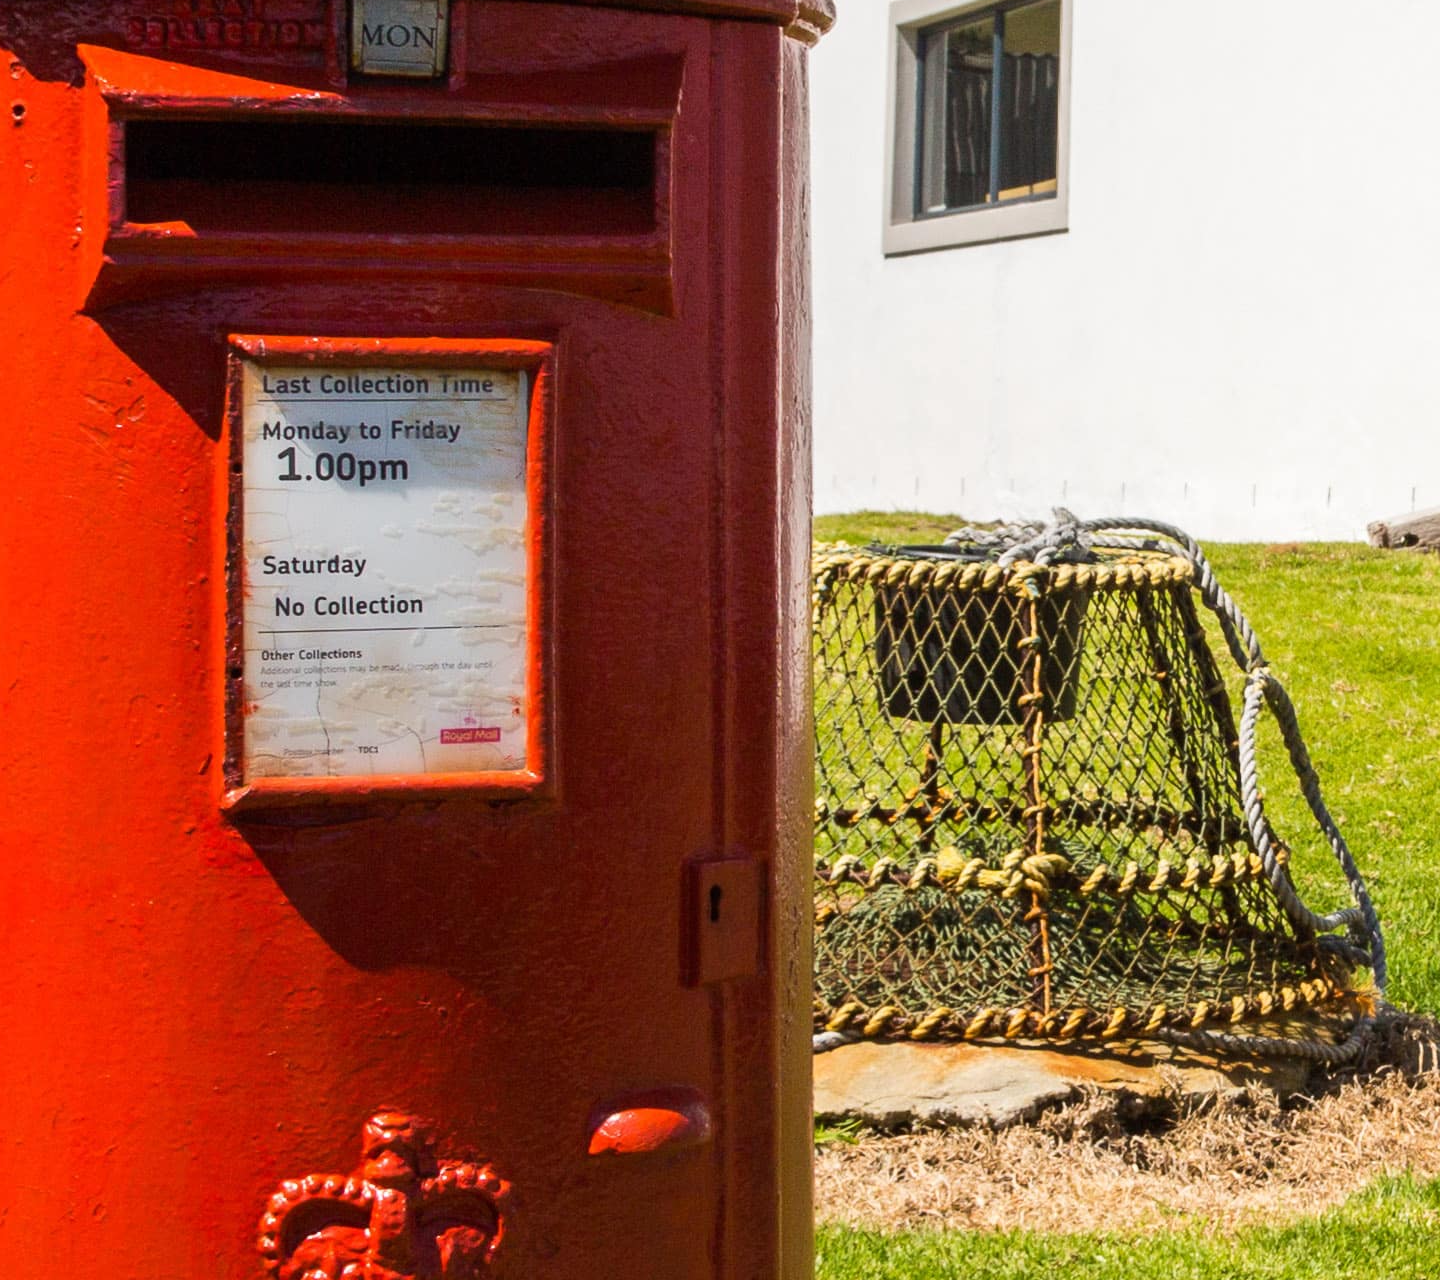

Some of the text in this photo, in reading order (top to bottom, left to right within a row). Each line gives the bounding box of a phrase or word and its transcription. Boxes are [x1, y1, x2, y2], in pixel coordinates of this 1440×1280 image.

[126, 18, 323, 47] COLLECTION
[362, 23, 437, 49] MON
[262, 374, 494, 394] Last Collection Time
[262, 420, 461, 444] Monday to Friday
[277, 446, 409, 487] 1.00pm
[262, 554, 367, 577] Saturday
[274, 594, 424, 617] No Collection
[261, 648, 363, 661] Other Collections
[442, 728, 498, 742] Royal Mail
